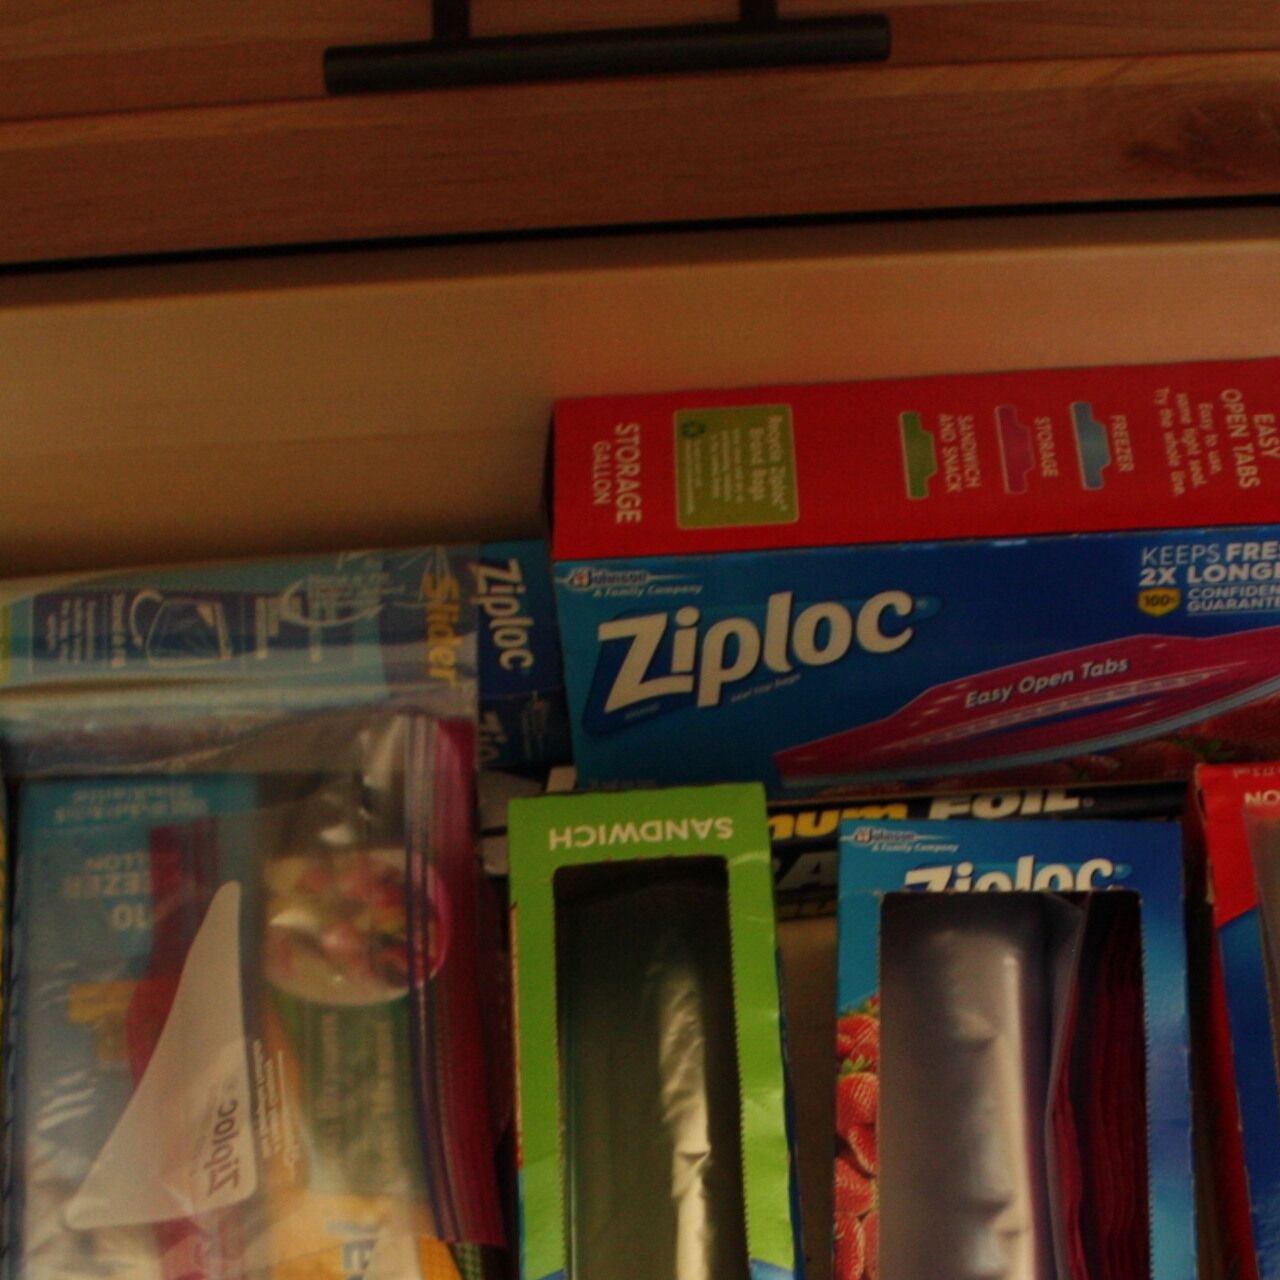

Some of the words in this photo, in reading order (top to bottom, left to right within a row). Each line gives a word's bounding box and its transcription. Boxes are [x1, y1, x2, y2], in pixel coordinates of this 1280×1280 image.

[938, 413, 958, 443] AND
[1220, 388, 1252, 440] OPEN
[942, 445, 965, 493] SNACK
[957, 414, 982, 489] SANDWICH
[1034, 416, 1059, 479] STORAGE
[1110, 414, 1135, 473] FREEZER
[1234, 443, 1261, 489] TABS
[592, 440, 614, 506] GALLON
[614, 422, 642, 525] STORAGE
[1139, 566, 1177, 587] 2X
[1140, 544, 1221, 566] KEEPS
[422, 575, 464, 687] Slider
[468, 558, 535, 671] Ziploc
[597, 590, 914, 714] Ziploc
[964, 681, 1014, 709] Easy
[1017, 669, 1075, 696] Open
[1080, 656, 1129, 681] Tabs
[549, 816, 734, 852] SANDWICH
